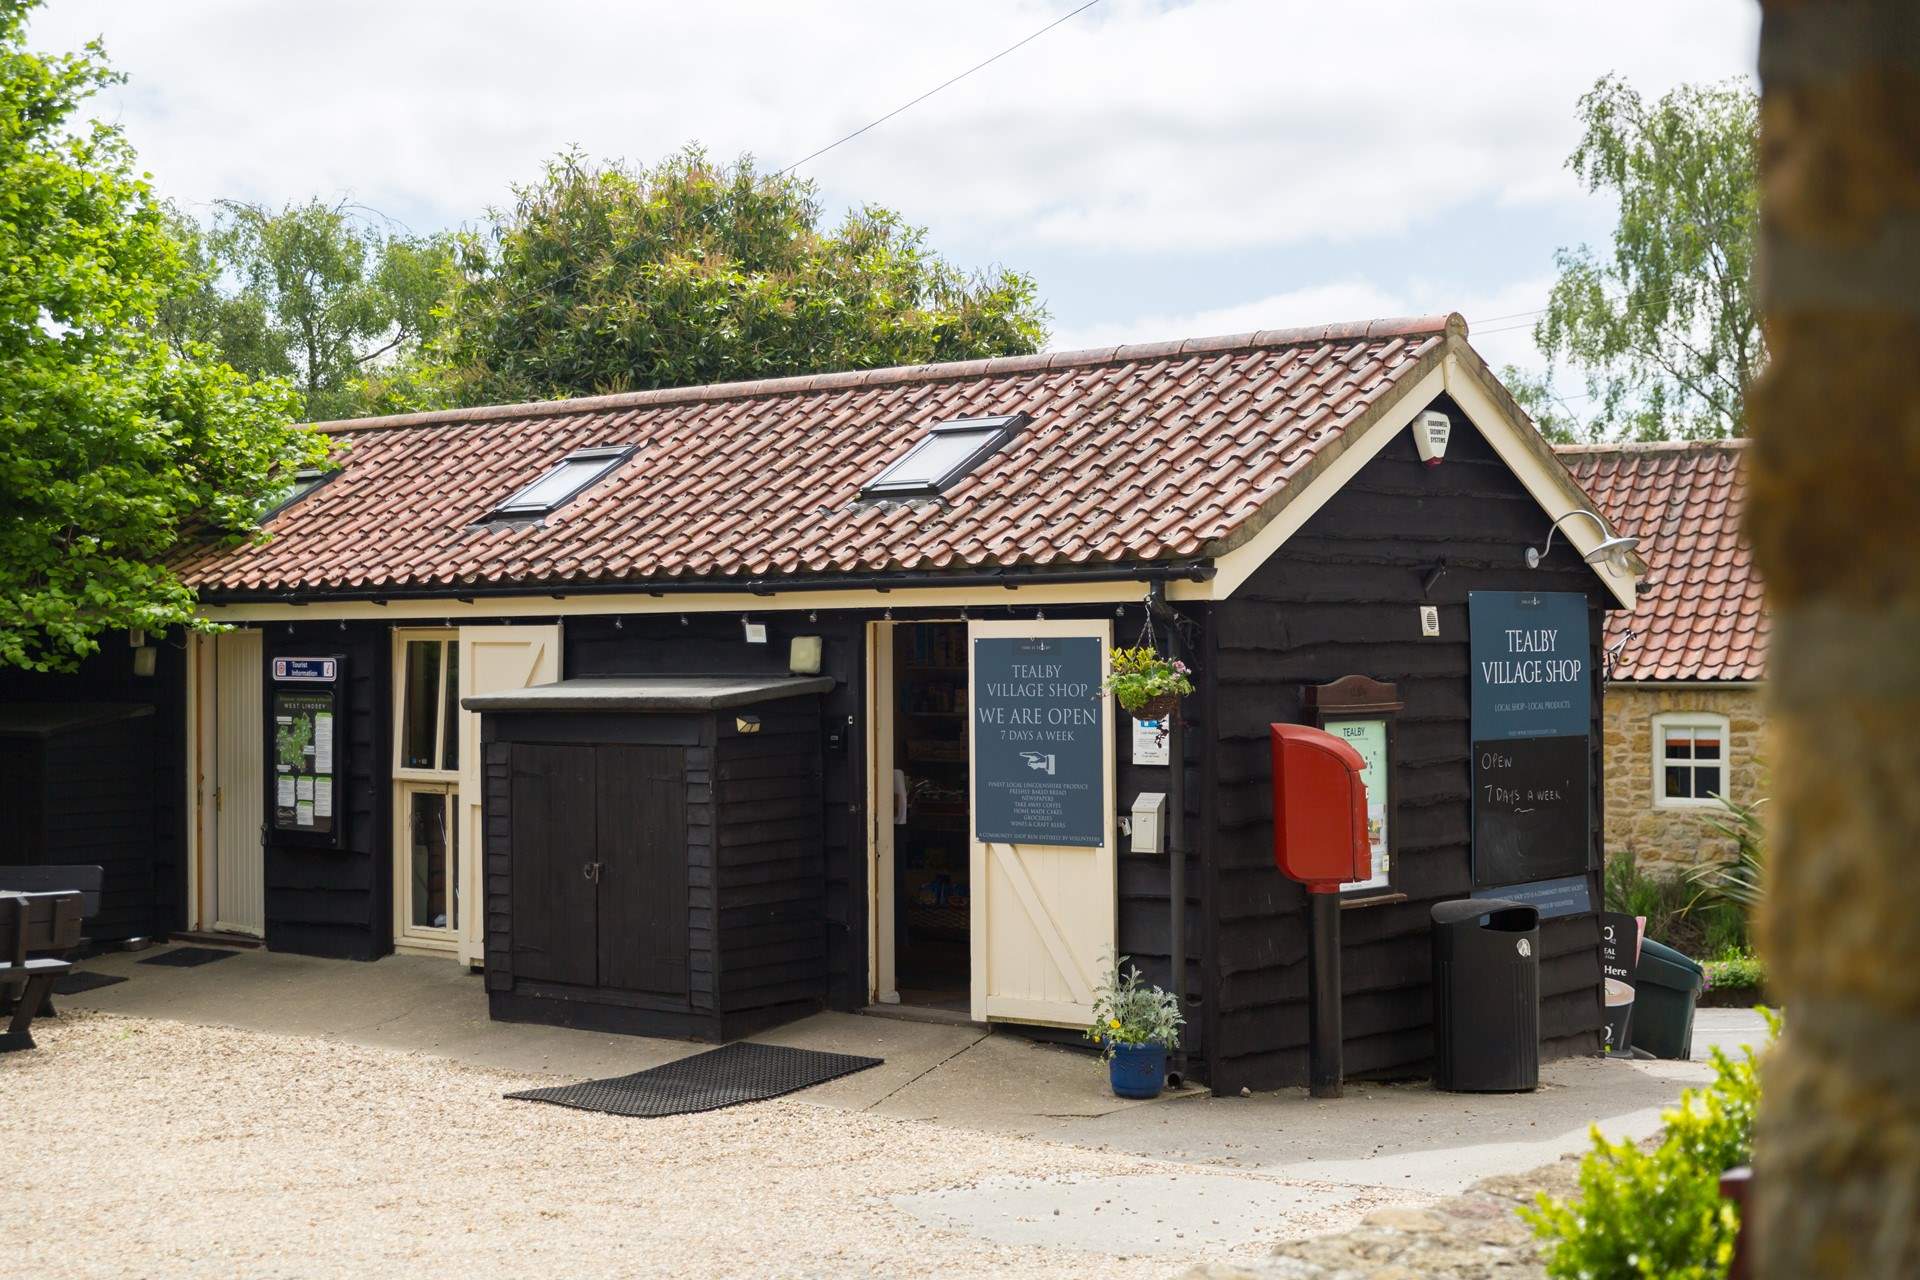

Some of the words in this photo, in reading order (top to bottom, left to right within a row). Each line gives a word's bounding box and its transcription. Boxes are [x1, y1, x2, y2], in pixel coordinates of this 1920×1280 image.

[1505, 630, 1558, 652] TEALBY
[1012, 664, 1062, 678] TEALBY
[1482, 660, 1542, 684] VILLAGE
[1546, 659, 1581, 683] SHOP
[987, 683, 1044, 697] VILLAGE
[1048, 683, 1088, 697] SHOP
[1494, 702, 1511, 712] LOCAL
[1528, 701, 1544, 711] LOCAL
[979, 707, 1005, 724] WE
[1010, 707, 1042, 724] ARE
[1048, 708, 1096, 725] OPEN
[1000, 730, 1006, 741] 7
[1009, 730, 1034, 741] DAYS
[1036, 730, 1043, 741] A
[1046, 730, 1074, 741] WEEK
[1342, 727, 1365, 737] TEALBY
[1482, 752, 1512, 769] OPEN
[1484, 784, 1492, 803] 7
[1496, 787, 1520, 805] DAYS
[1527, 790, 1533, 800] A
[1604, 965, 1627, 976] Here
